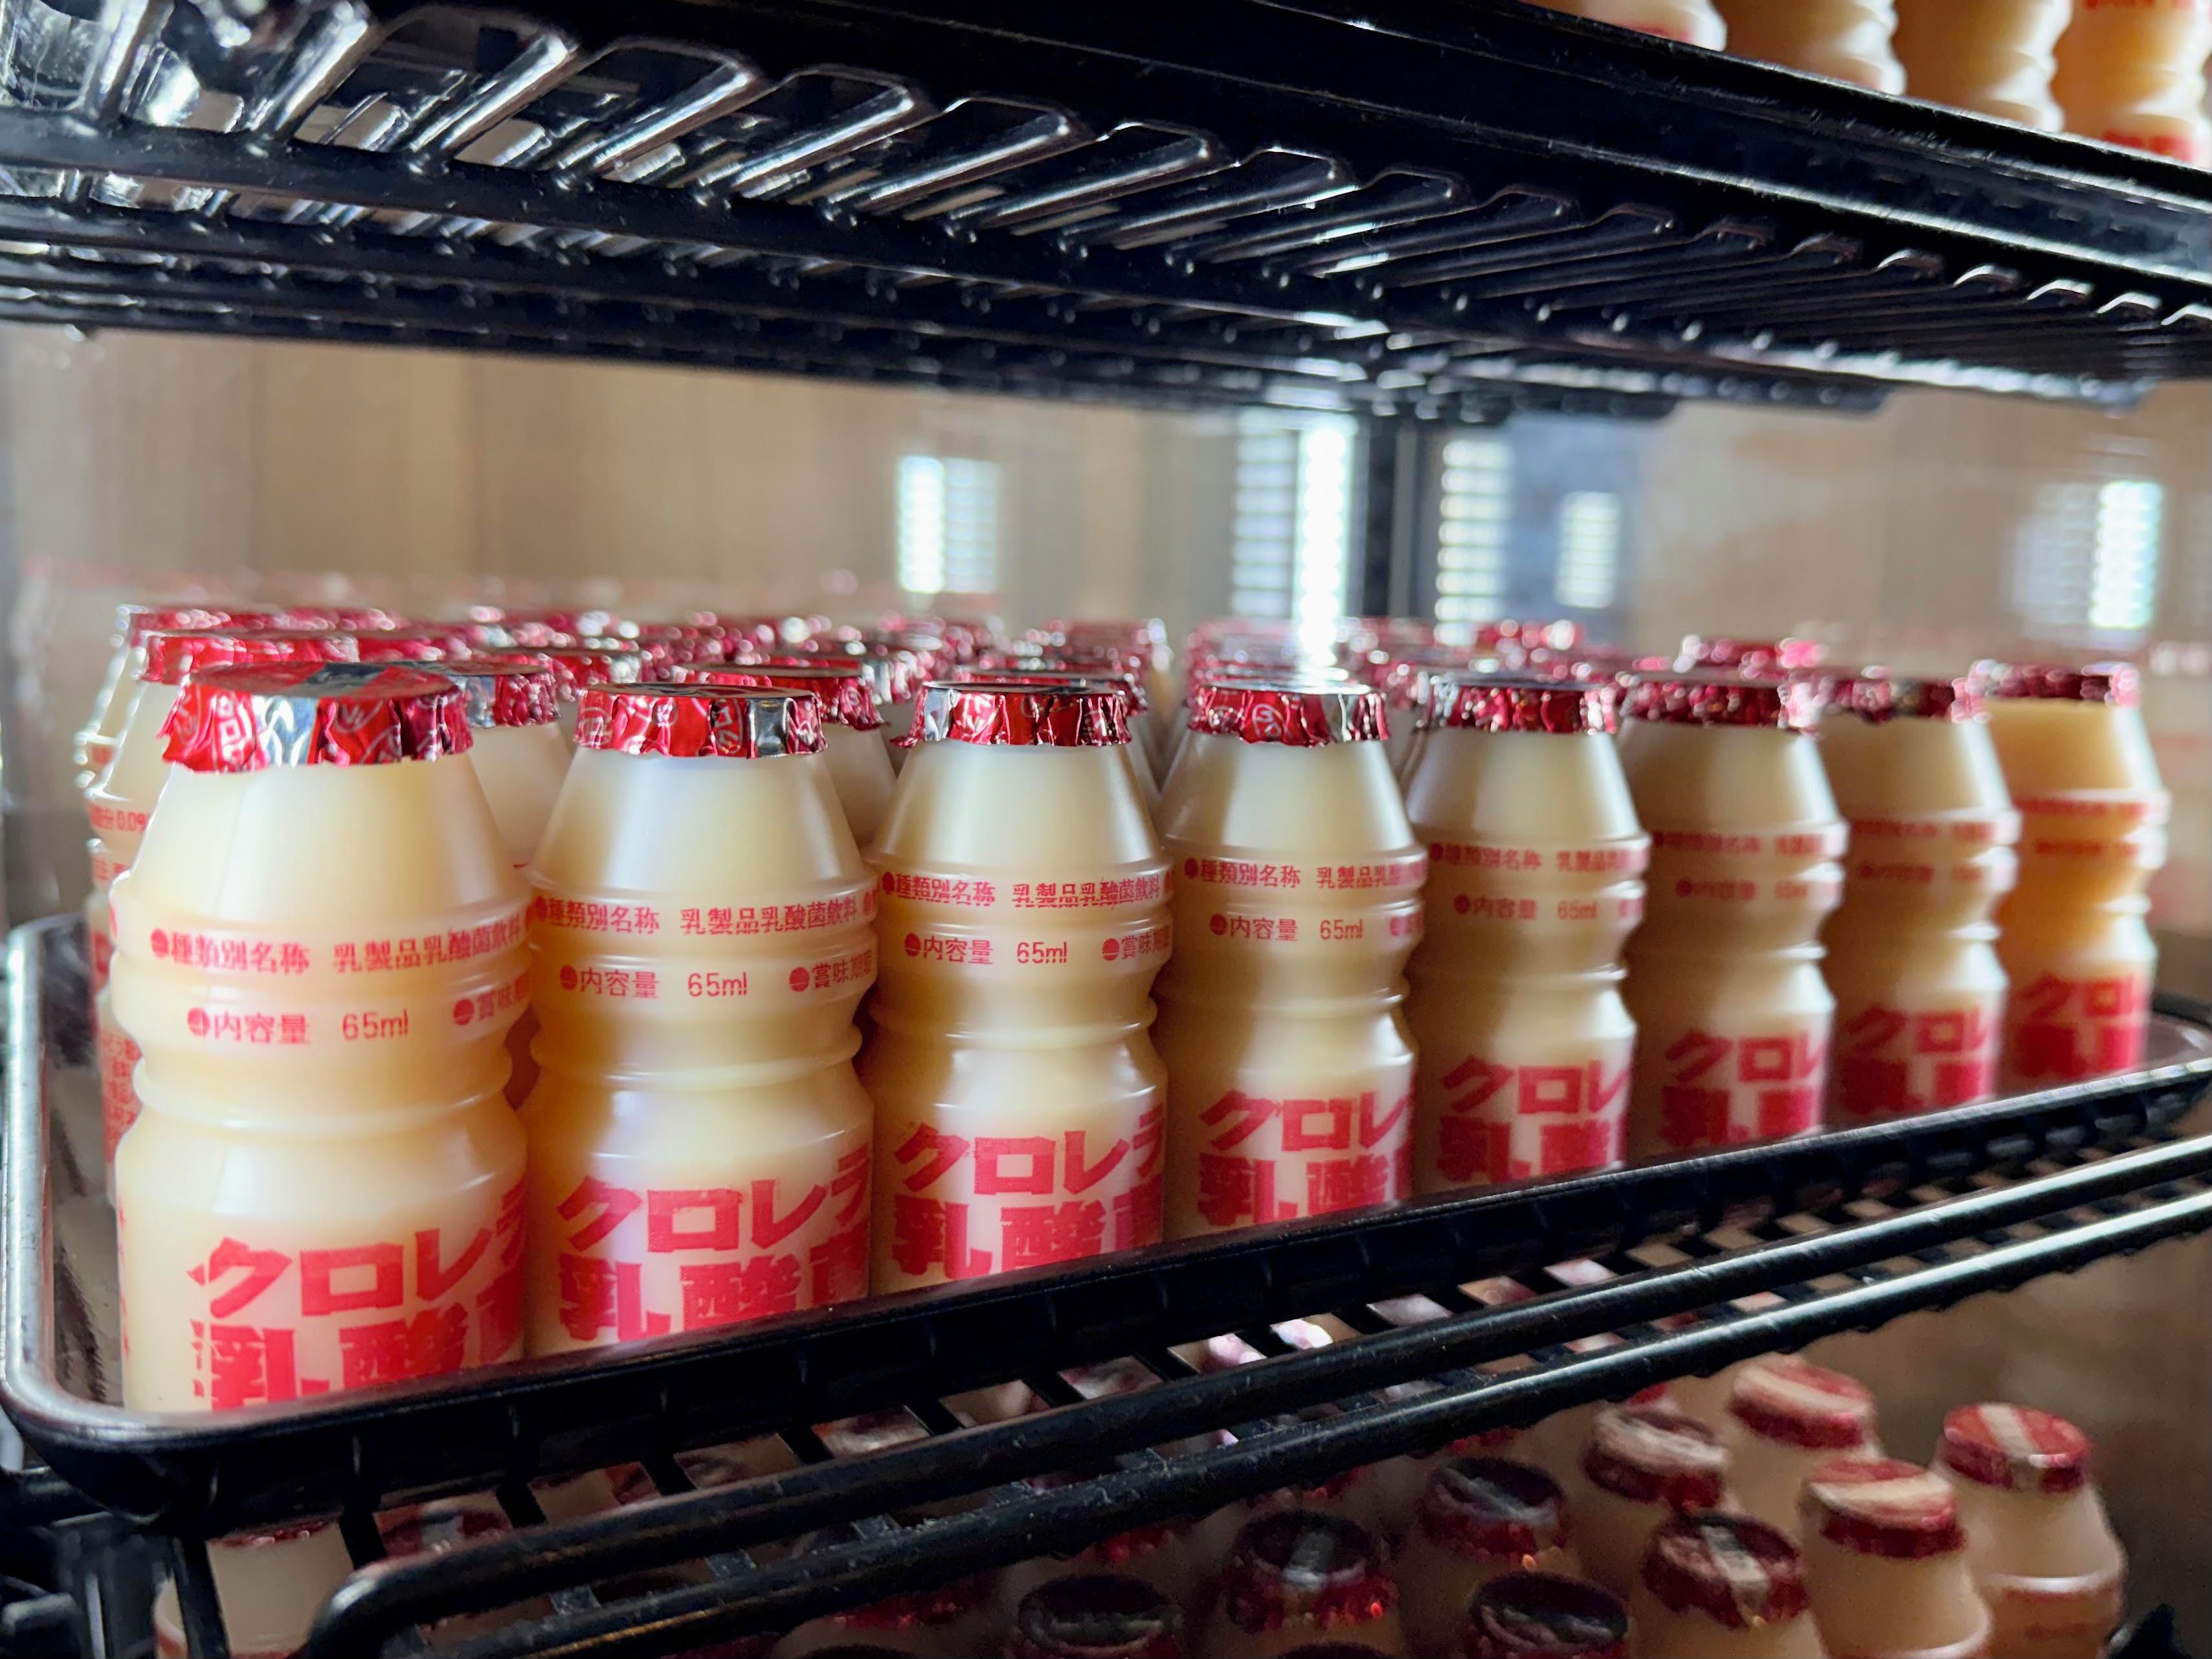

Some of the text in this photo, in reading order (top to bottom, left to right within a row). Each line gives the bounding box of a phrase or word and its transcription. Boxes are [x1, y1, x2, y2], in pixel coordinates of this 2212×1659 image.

[895, 873, 996, 906] 種類別名称
[1012, 873, 1159, 909] 乳製品乳酸菌飲料
[548, 897, 660, 934] 種類別名称
[680, 895, 856, 935] 乳製品乳酸菌飲料
[1230, 915, 1363, 942] 内容量 65ml
[169, 930, 310, 975] 種類別名称
[923, 936, 1068, 964] 内容量 65ml
[581, 966, 747, 999] 内容量 65ml
[211, 1008, 409, 1044] 内容量 65ml
[1199, 1082, 1415, 1152] クロレ
[894, 1104, 1163, 1195] クロレラ
[557, 1143, 869, 1253] クロレラ
